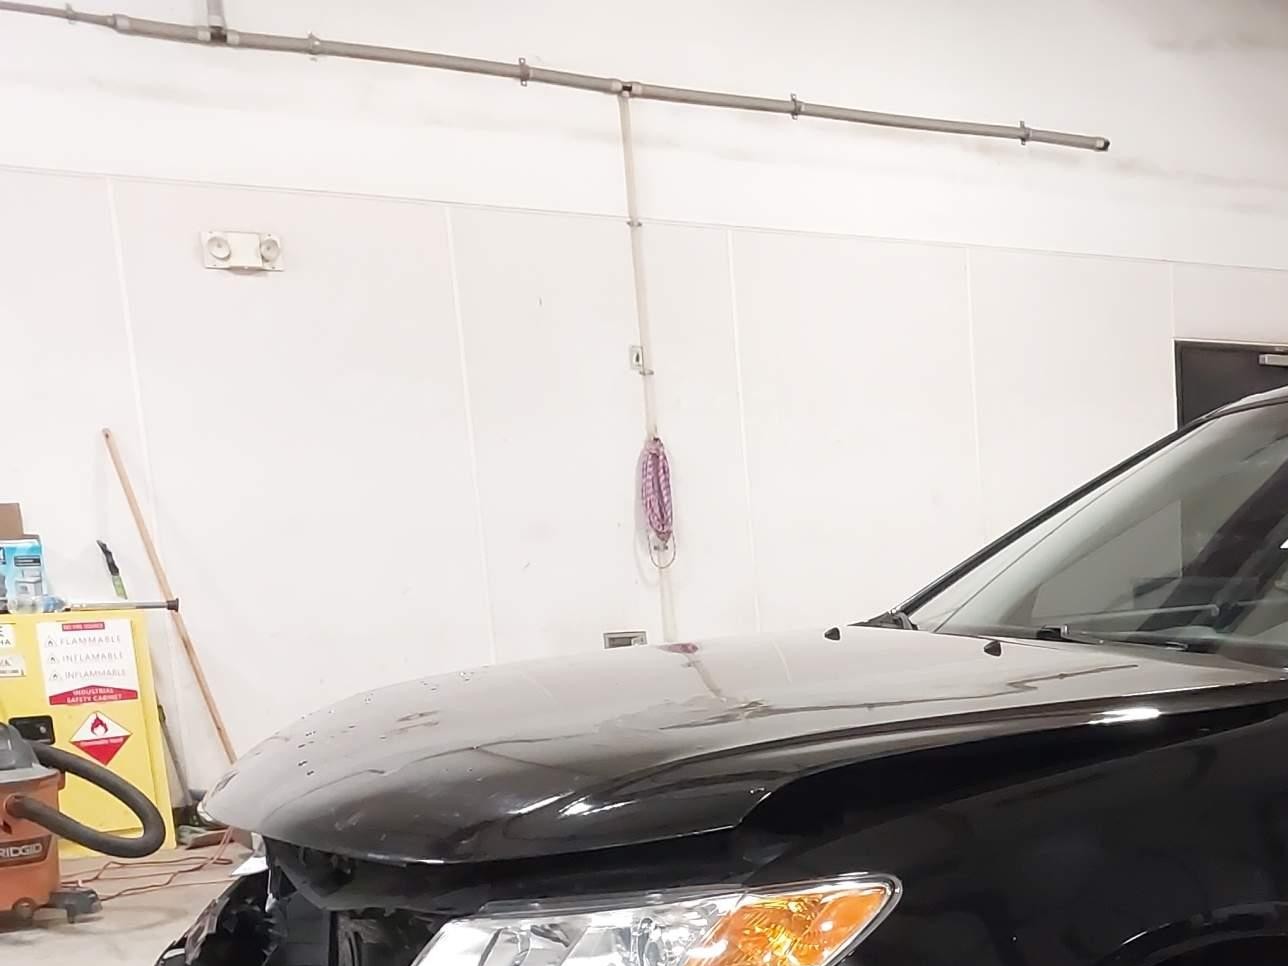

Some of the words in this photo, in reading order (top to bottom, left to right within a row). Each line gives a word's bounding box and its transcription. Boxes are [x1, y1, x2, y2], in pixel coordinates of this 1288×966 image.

[60, 634, 121, 646] FLAMMABLE
[62, 651, 123, 663] INFLAMABLE
[64, 669, 126, 680] INFLAMMABLE
[72, 687, 114, 696] INDUSTRIAL
[66, 696, 92, 704] SAFETY
[92, 694, 122, 702] CABINET
